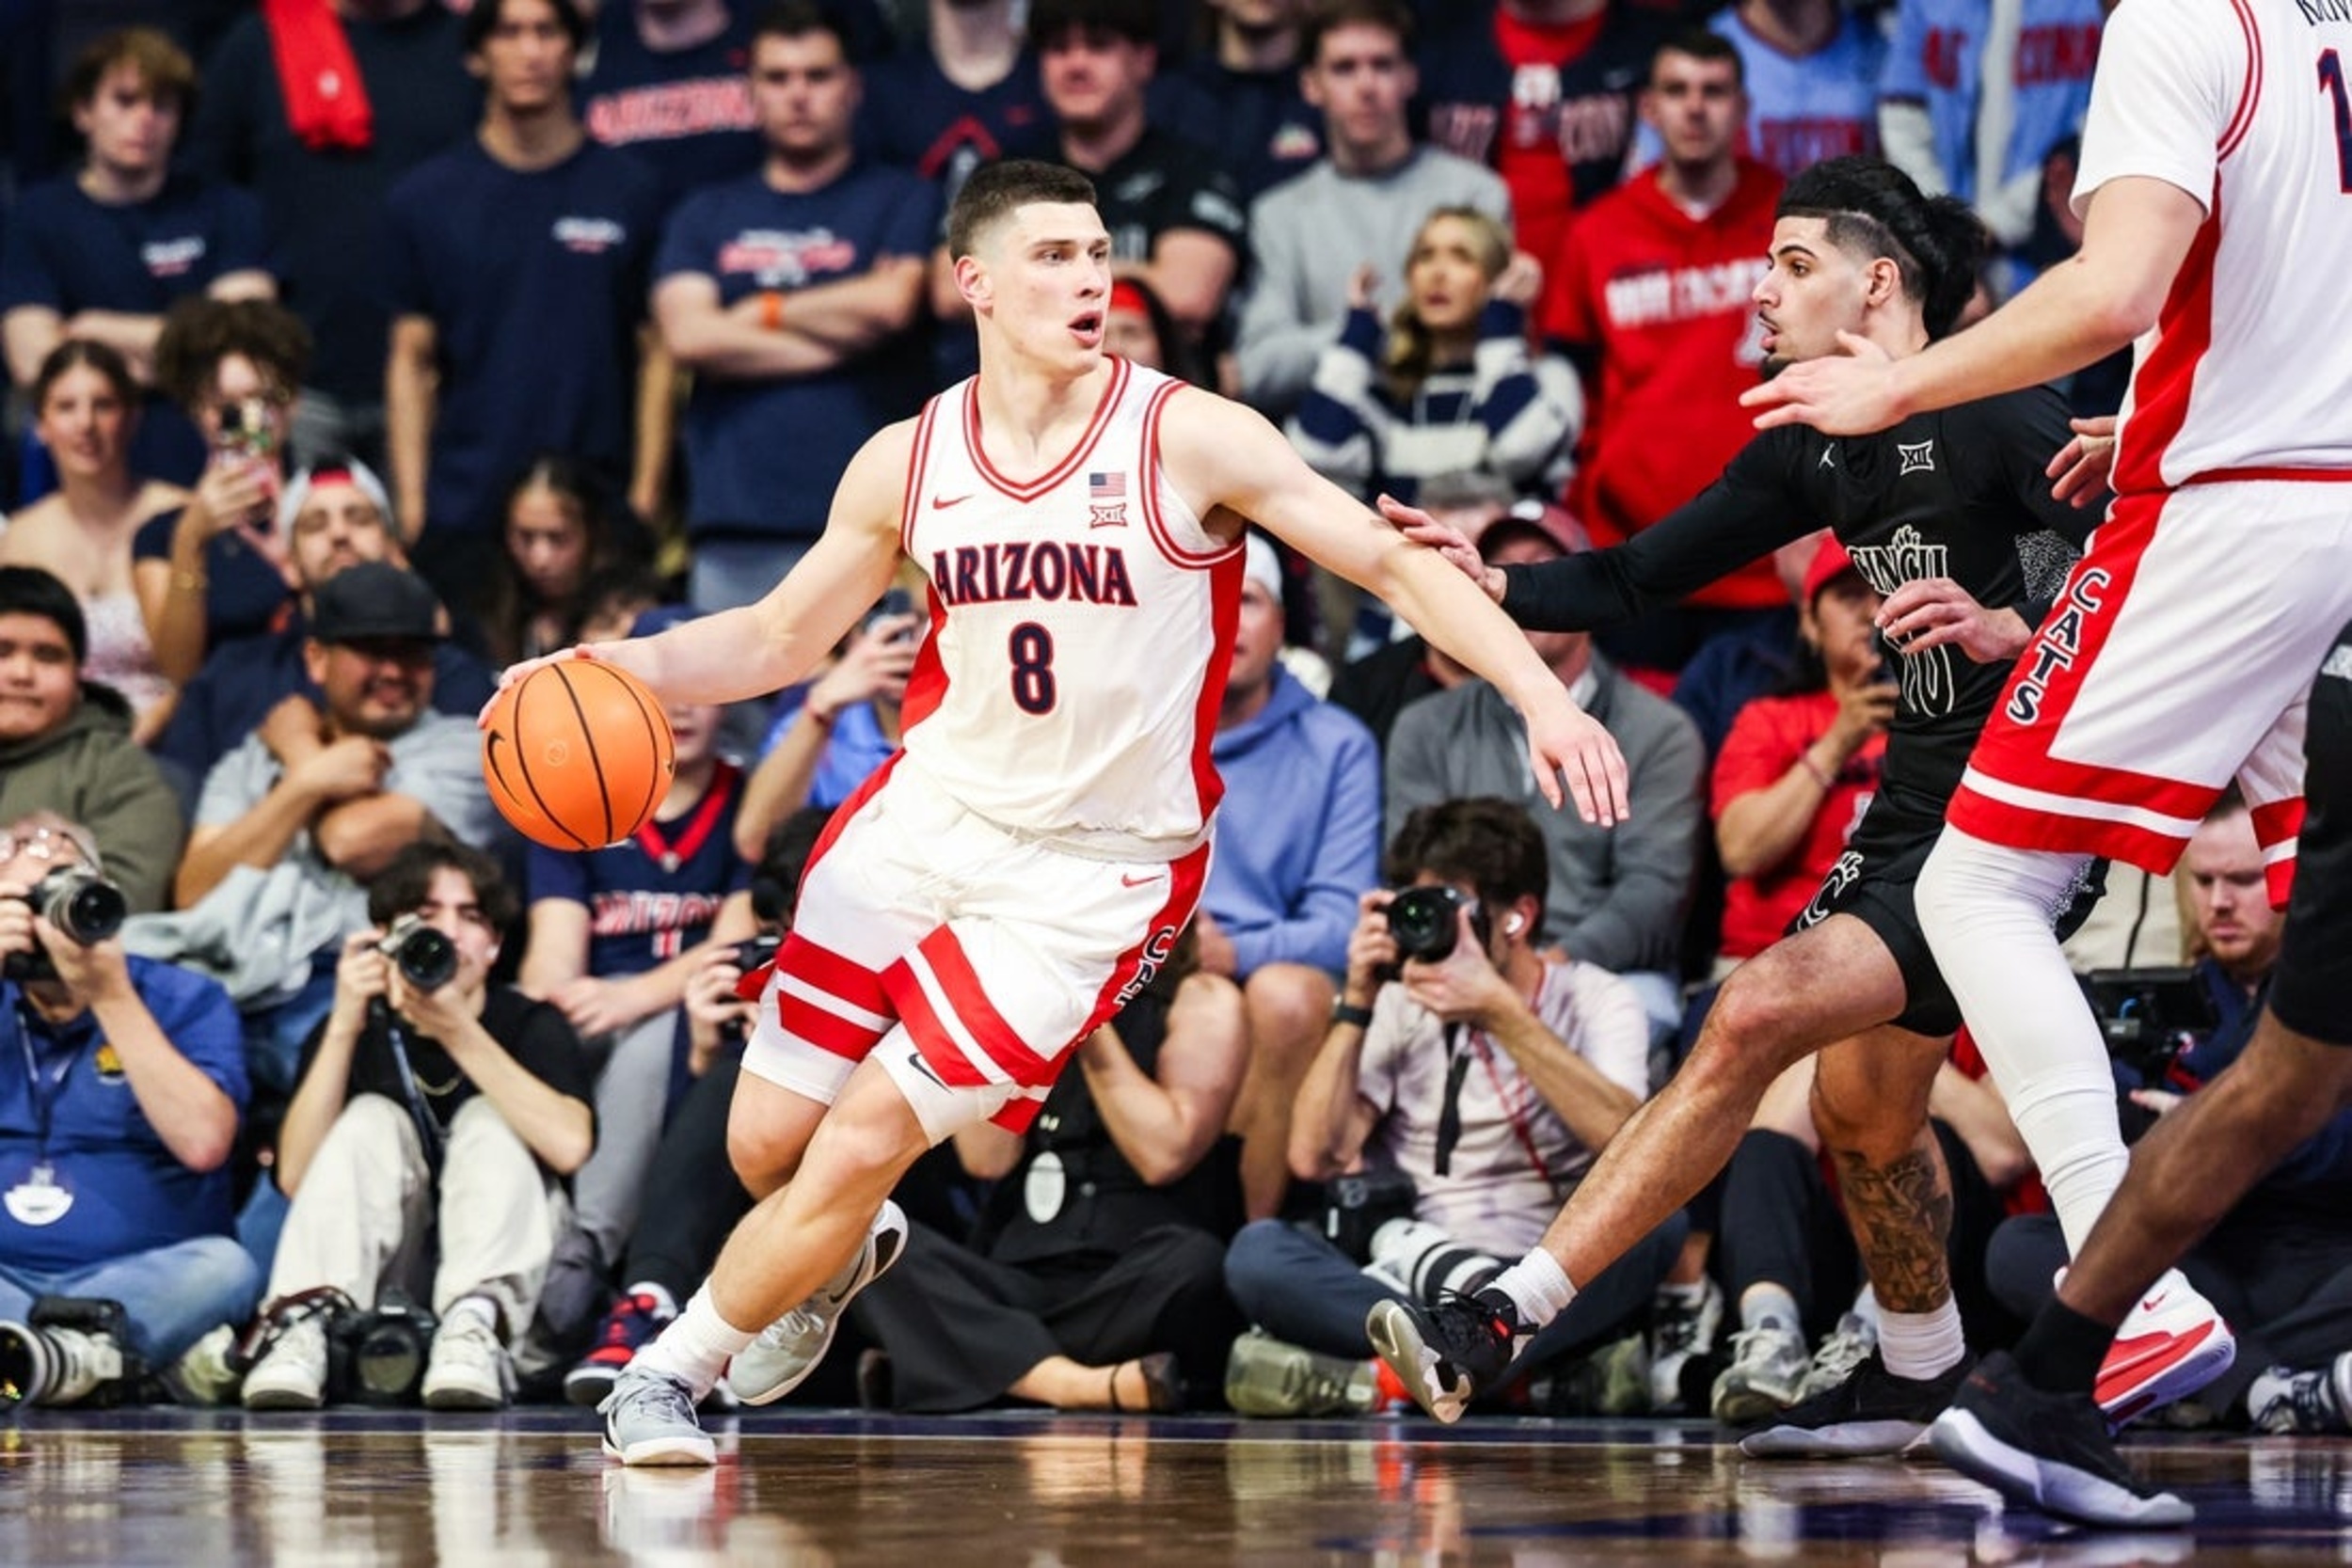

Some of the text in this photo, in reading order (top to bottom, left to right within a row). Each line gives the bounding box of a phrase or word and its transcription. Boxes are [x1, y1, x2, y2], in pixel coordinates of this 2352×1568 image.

[932, 540, 1139, 608] ARIZONA
[1008, 620, 1057, 717] 8
[2006, 566, 2112, 726] CATS
